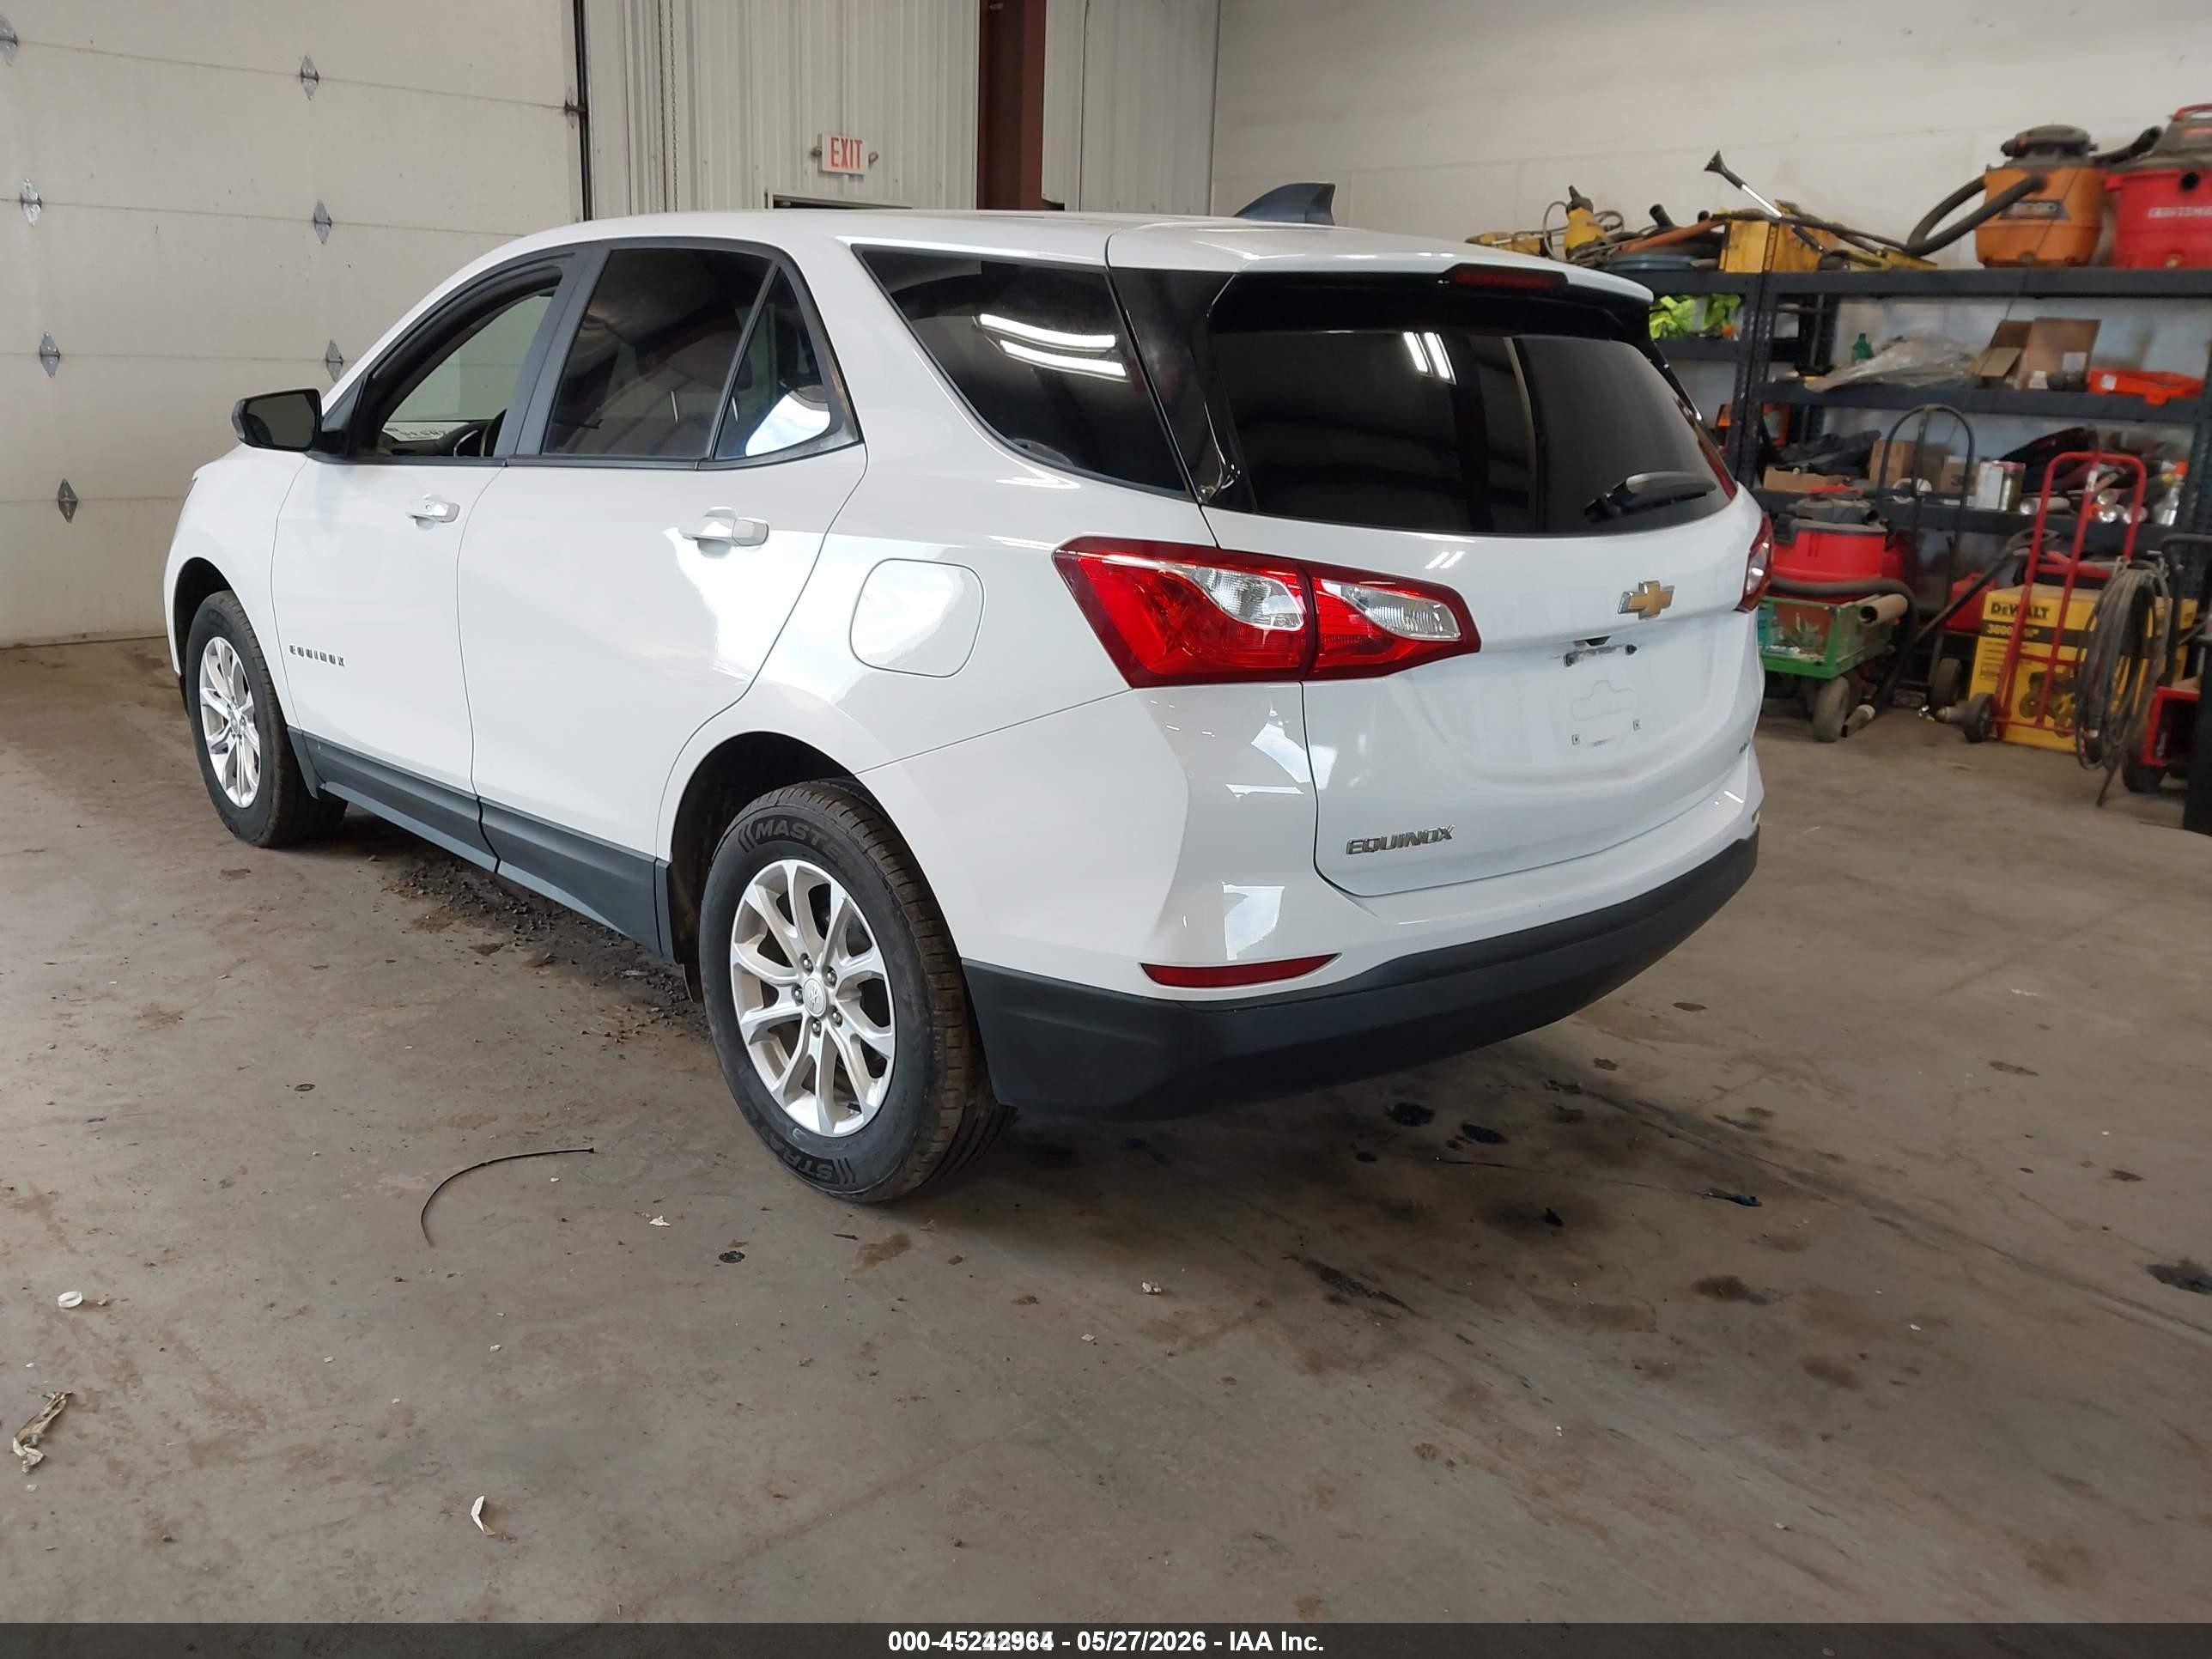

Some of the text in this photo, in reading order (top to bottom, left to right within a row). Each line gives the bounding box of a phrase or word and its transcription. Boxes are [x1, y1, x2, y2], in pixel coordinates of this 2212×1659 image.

[830, 137, 863, 170] EXIT
[289, 645, 345, 666] EQUINOX
[1346, 824, 1455, 854] EQUINOX
